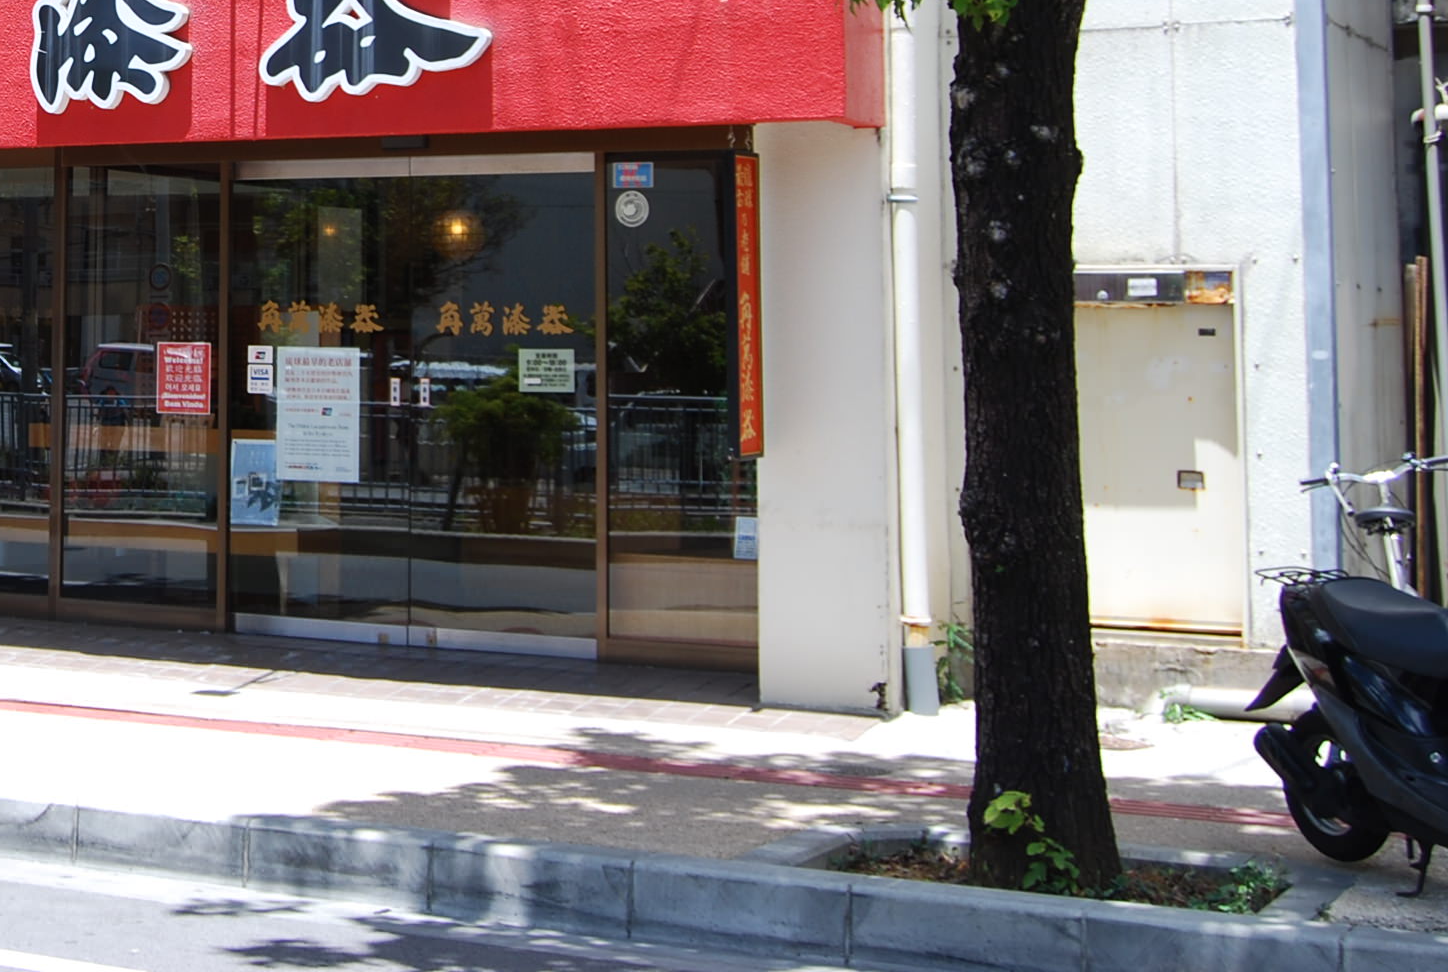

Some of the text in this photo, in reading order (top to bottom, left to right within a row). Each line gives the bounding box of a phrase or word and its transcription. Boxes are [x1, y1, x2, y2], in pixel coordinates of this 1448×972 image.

[257, 300, 385, 333] 角萬漆器
[436, 301, 575, 336] 角萬漆器
